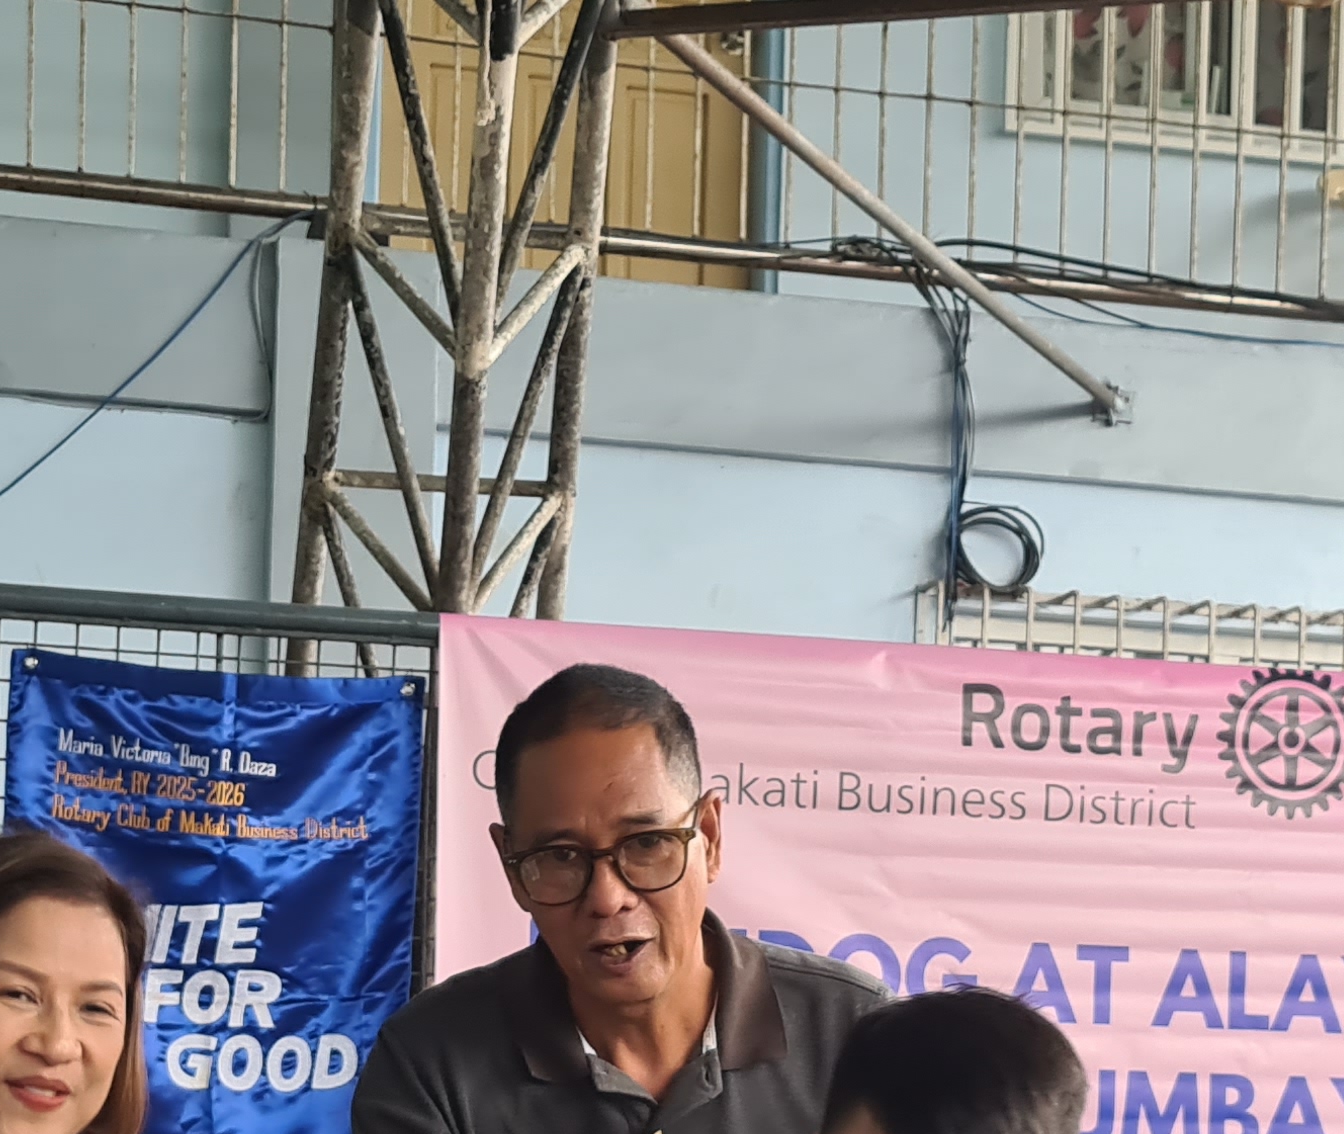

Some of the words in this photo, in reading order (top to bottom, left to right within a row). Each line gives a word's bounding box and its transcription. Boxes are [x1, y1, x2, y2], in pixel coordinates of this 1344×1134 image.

[57, 727, 104, 756] Maria
[110, 734, 171, 765] Victoria
[221, 748, 234, 773] R.
[238, 751, 277, 777] Daza
[961, 683, 1198, 774] Rotary
[54, 760, 127, 794] President,
[131, 770, 149, 795] RY
[157, 773, 246, 807] 2025-2026
[711, 762, 819, 809] akati
[837, 771, 1027, 821] Business
[1043, 783, 1197, 829] District
[50, 794, 111, 831] Rotary
[116, 804, 150, 830] Club
[156, 808, 173, 832] of
[179, 811, 231, 837] Makati
[236, 815, 298, 840] Business
[306, 816, 369, 840] District
[143, 968, 283, 1029] FOR
[1015, 942, 1129, 1025] AT
[167, 1033, 359, 1093] GOOD
